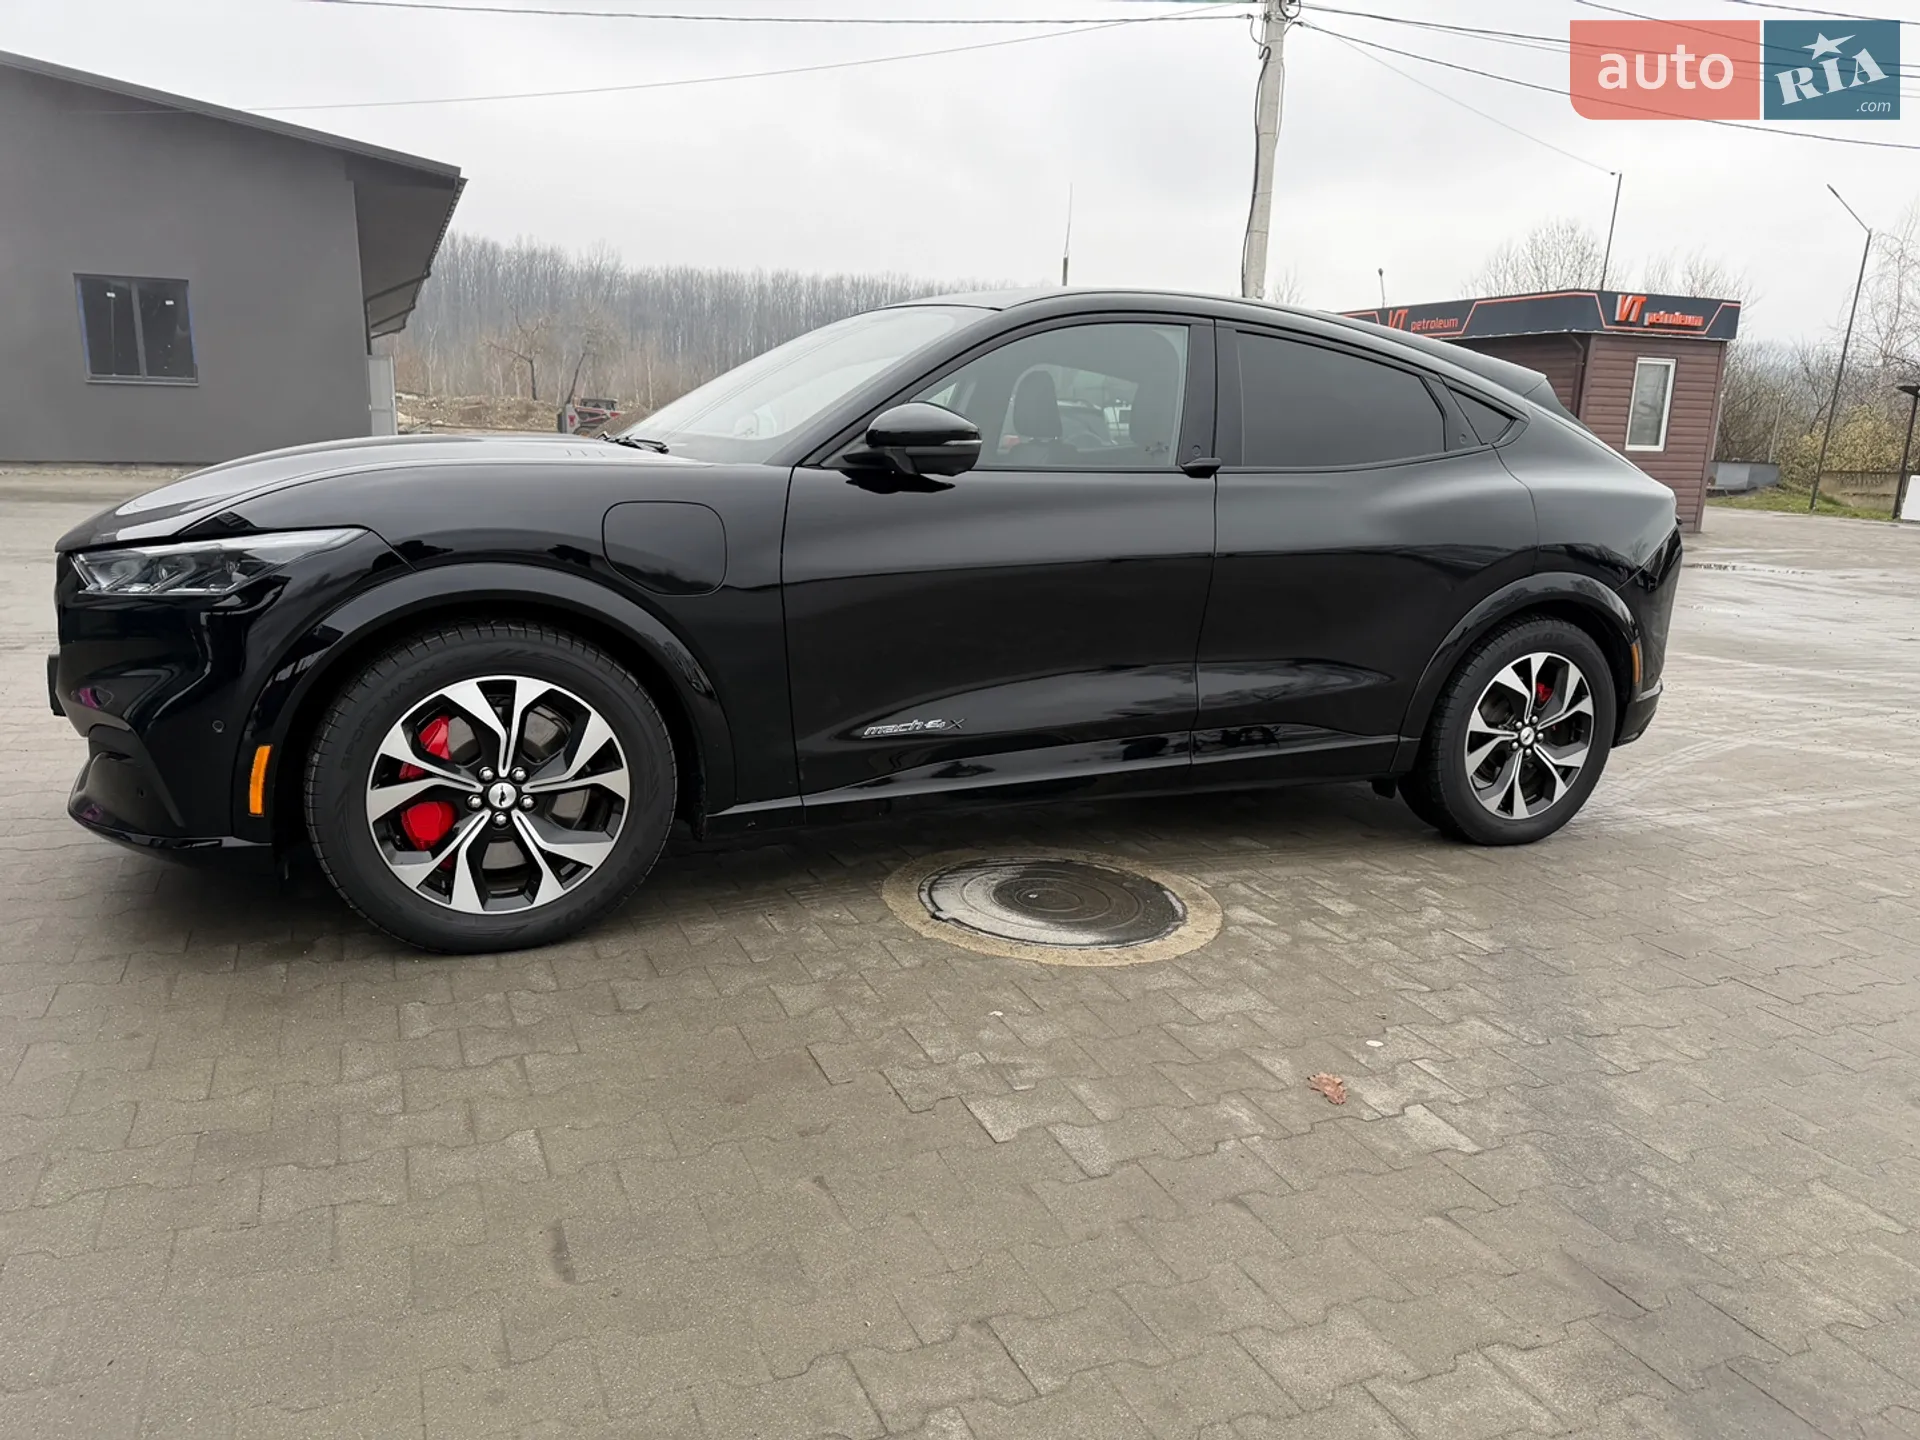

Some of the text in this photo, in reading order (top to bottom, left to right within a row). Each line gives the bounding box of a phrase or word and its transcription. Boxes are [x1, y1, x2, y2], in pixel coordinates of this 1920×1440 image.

[1387, 308, 1459, 333] VT petroleum
[1614, 294, 1647, 323] VT
[340, 664, 437, 771] SPORT MAXX
